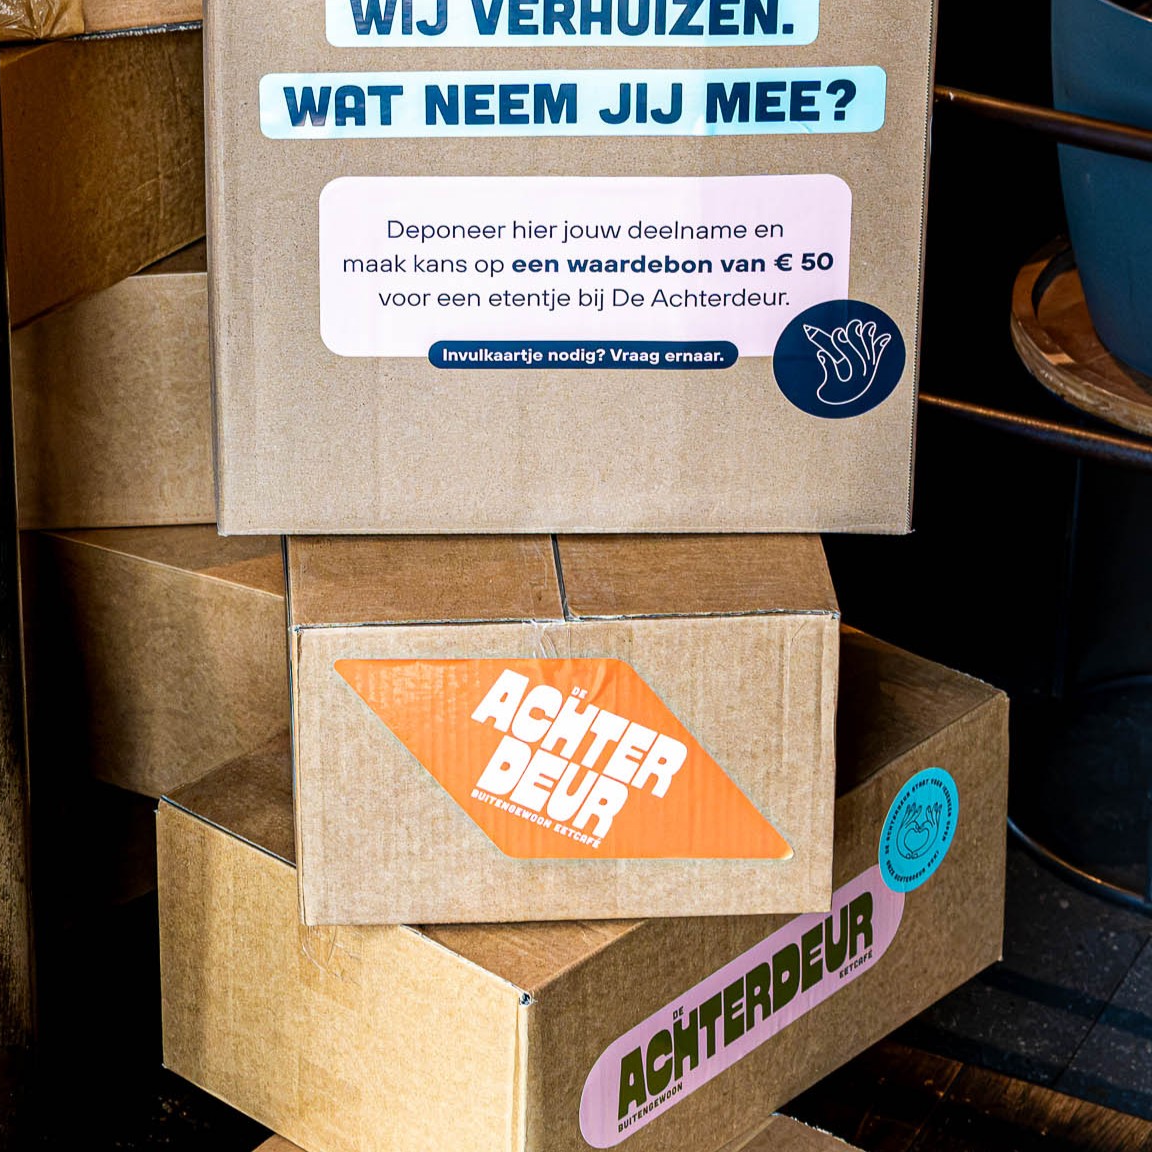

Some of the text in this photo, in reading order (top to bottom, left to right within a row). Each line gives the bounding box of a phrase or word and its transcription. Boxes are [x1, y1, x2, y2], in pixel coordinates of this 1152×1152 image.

[283, 79, 858, 127] WAT NEEM JIJ MEE?
[387, 219, 784, 244] Deponeer hier jouw deelname en
[343, 252, 834, 278] maak kans op een waardebon van € 50
[378, 286, 790, 312] voor een etentje bij De Achterdeur.
[442, 348, 724, 365] Invulkaartje nodig? Vraag ernaar.
[571, 686, 588, 699] DE
[470, 668, 688, 798] ACHTER
[476, 734, 628, 839] DEUR
[471, 788, 602, 848] BUITENGEWOON EETCAFÉ
[839, 949, 873, 979] EETCAFÉ
[618, 891, 873, 1121] ACHTERDEUR
[673, 1006, 684, 1020] DE
[618, 1082, 683, 1133] BUITENGEWOON
